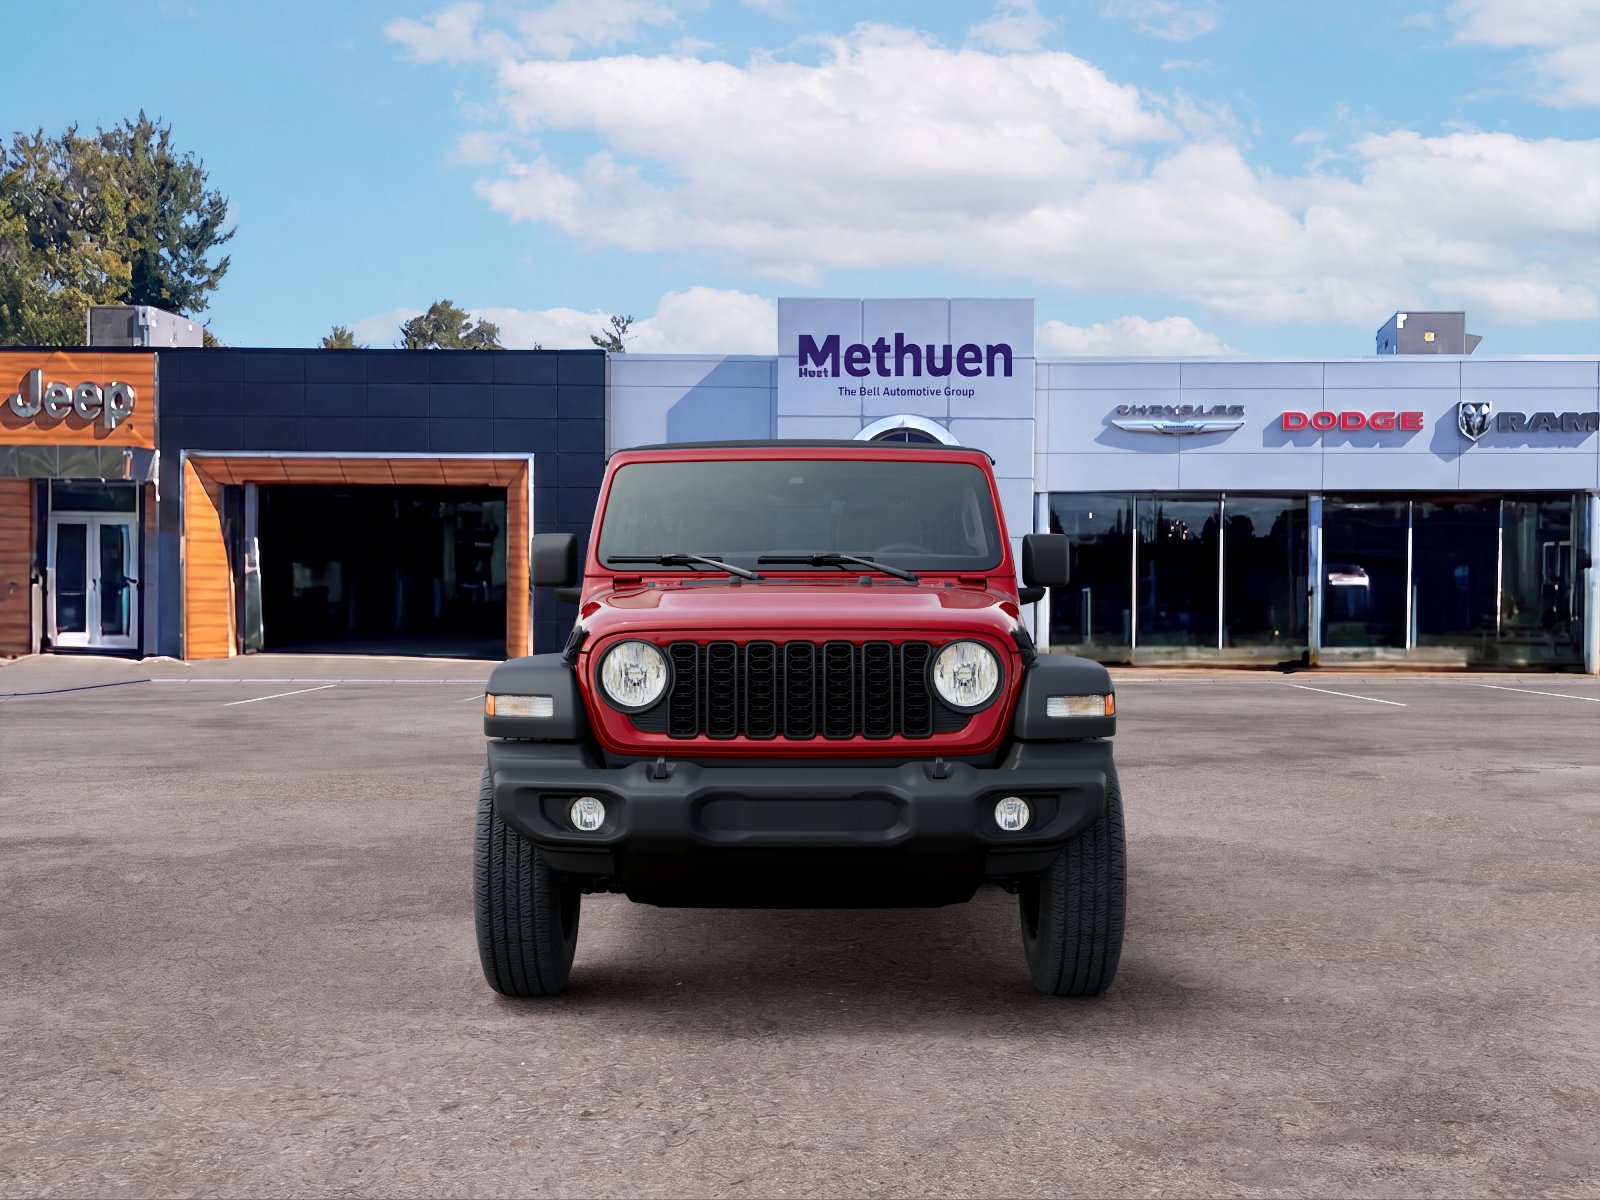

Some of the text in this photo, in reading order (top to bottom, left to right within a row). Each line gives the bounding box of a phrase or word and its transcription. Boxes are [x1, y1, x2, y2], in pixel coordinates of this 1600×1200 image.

[798, 332, 1013, 378] Methuen
[9, 368, 136, 429] Jeep
[838, 386, 975, 399] The Bell Automotive Group
[1282, 411, 1424, 431] DODGE
[1498, 411, 1600, 432] RAM
